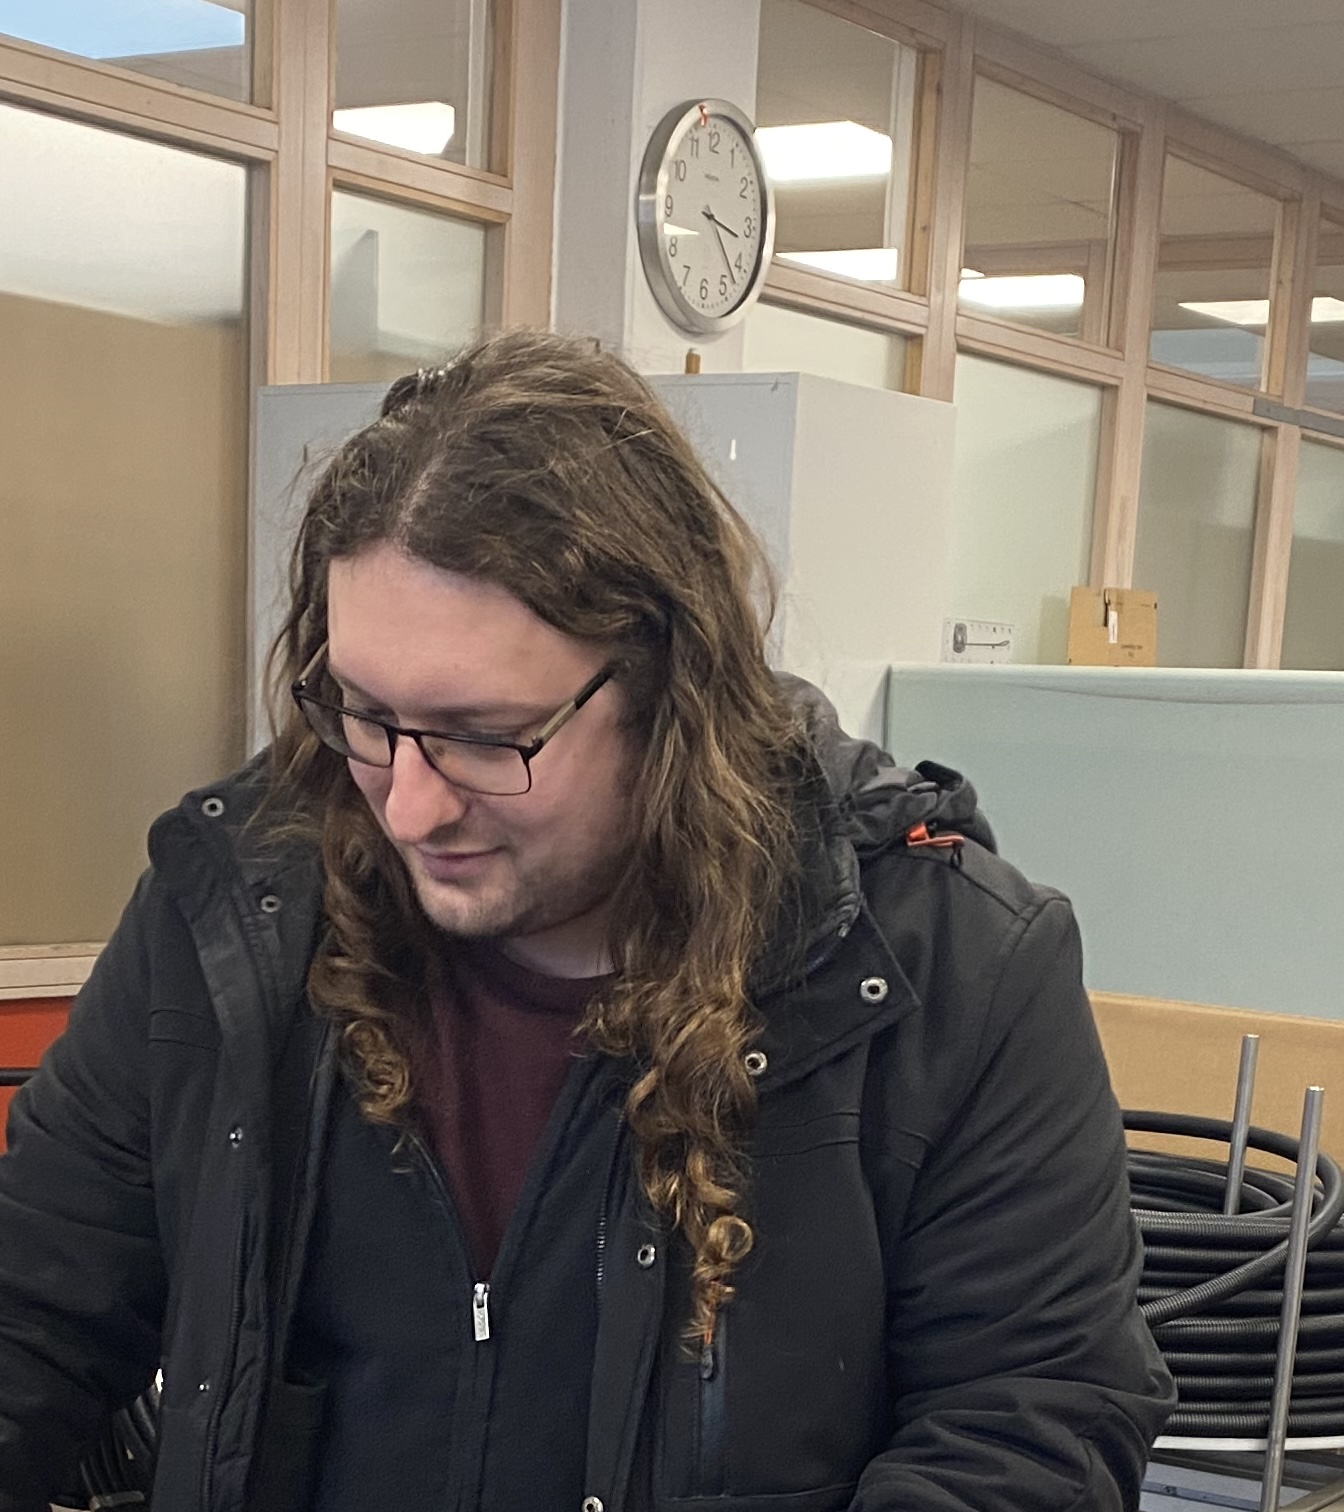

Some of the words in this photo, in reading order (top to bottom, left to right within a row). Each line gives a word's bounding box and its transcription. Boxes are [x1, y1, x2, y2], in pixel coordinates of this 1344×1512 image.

[691, 136, 699, 158] 11
[708, 130, 721, 154] 12
[730, 147, 735, 169] 1
[672, 160, 687, 182] 10
[739, 176, 749, 200] 2
[665, 195, 673, 217] 9
[743, 216, 752, 239] 3
[669, 236, 678, 257] 8
[734, 251, 743, 273] 4
[682, 264, 691, 287] 7
[718, 274, 727, 296] 5
[700, 278, 709, 301] 6
